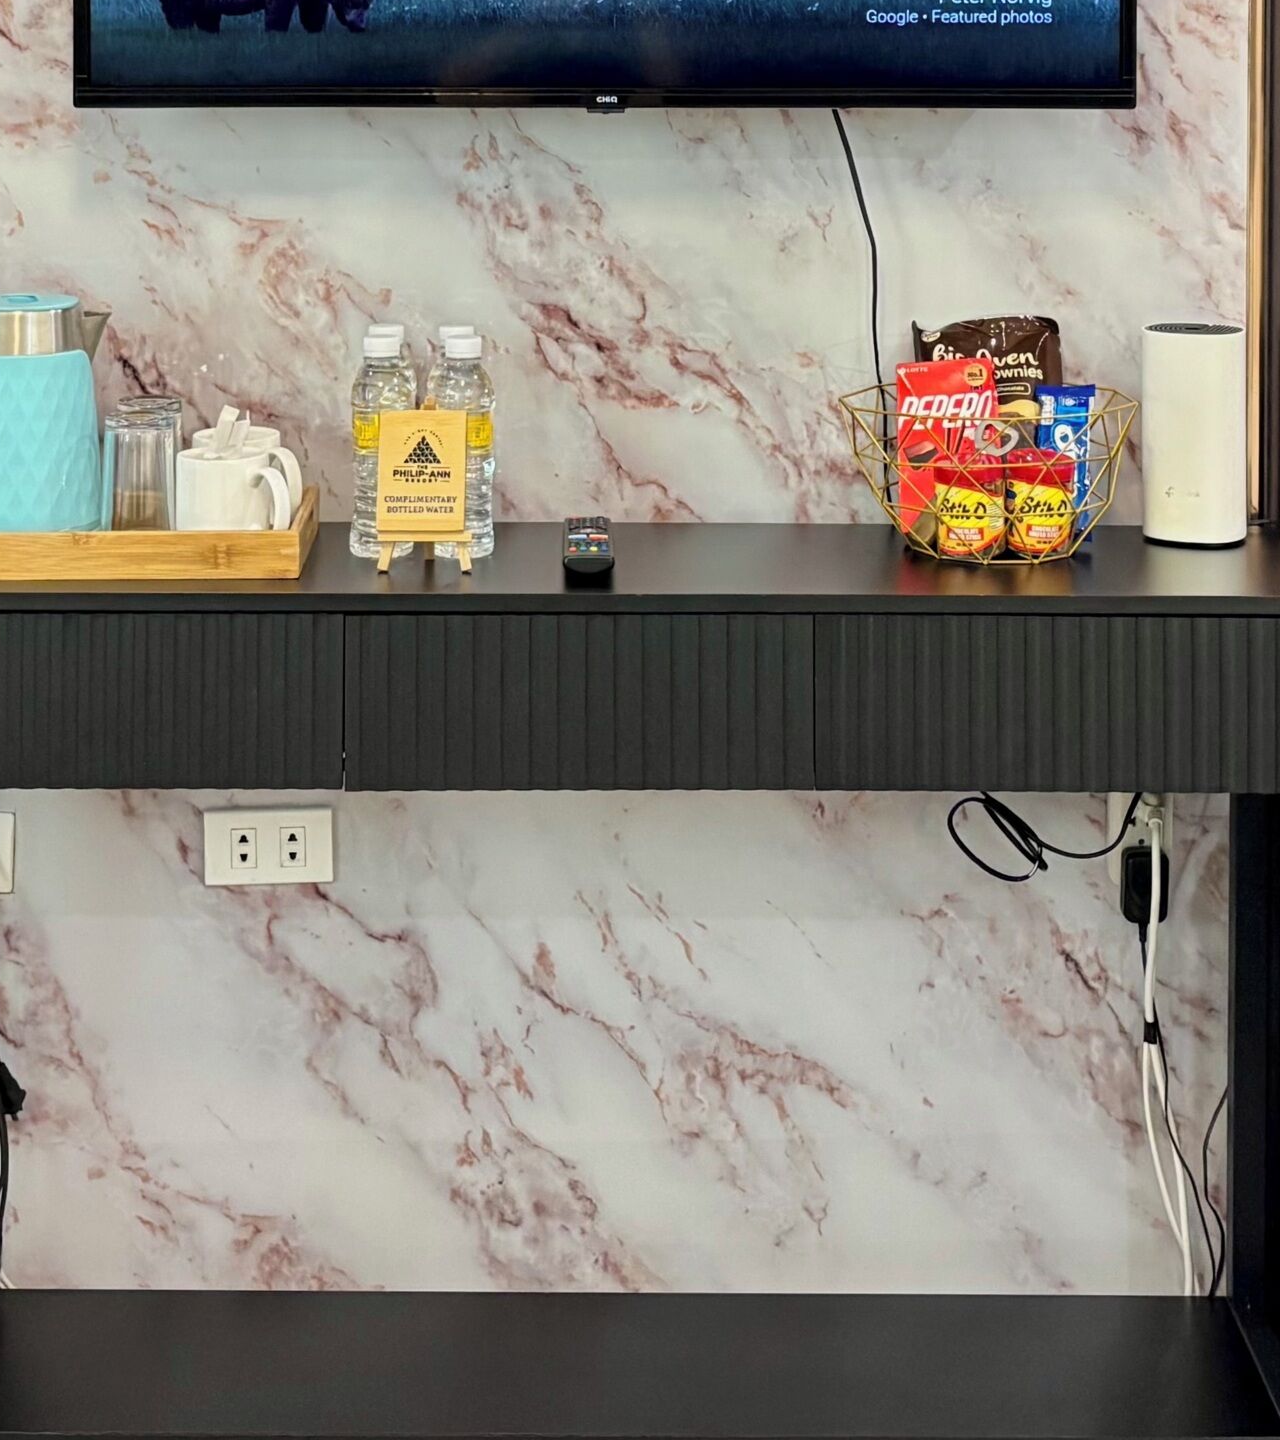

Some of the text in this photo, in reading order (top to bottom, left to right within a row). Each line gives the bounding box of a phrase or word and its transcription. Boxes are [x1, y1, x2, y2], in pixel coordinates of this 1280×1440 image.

[866, 9, 1052, 26] Google Featured photos
[898, 391, 993, 430] PEPERO
[393, 469, 451, 478] PHILIP-ANN
[384, 495, 458, 504] COMPLIMENTARY
[387, 505, 454, 514] BOTTLED WATER
